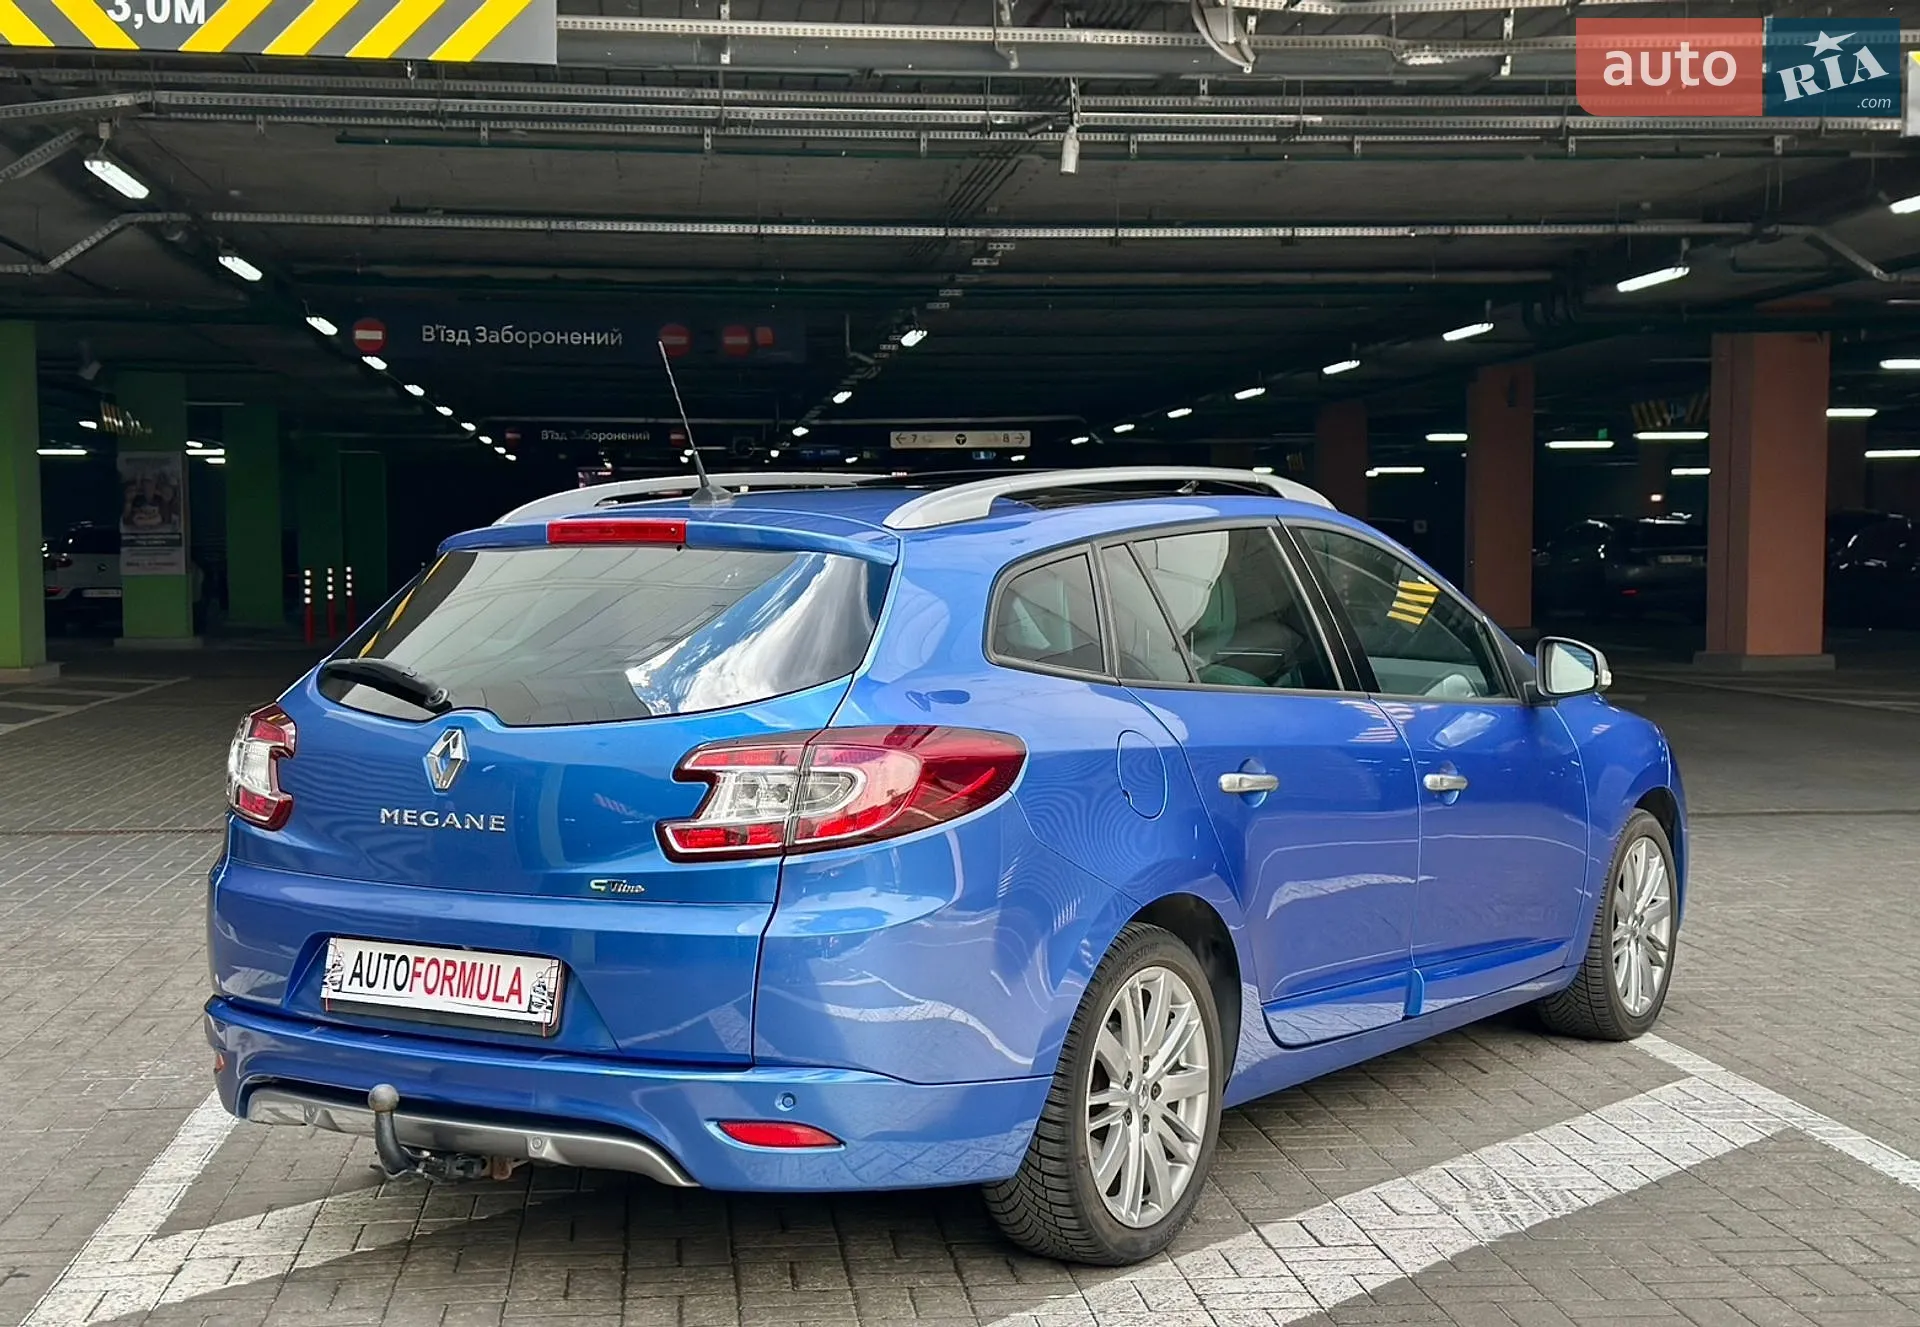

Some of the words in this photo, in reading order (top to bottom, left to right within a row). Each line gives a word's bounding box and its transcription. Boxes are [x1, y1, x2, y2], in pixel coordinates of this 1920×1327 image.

[474, 324, 624, 349] Заборонений
[380, 807, 507, 833] MEGANE
[348, 950, 523, 1005] AUTOFORMULA
